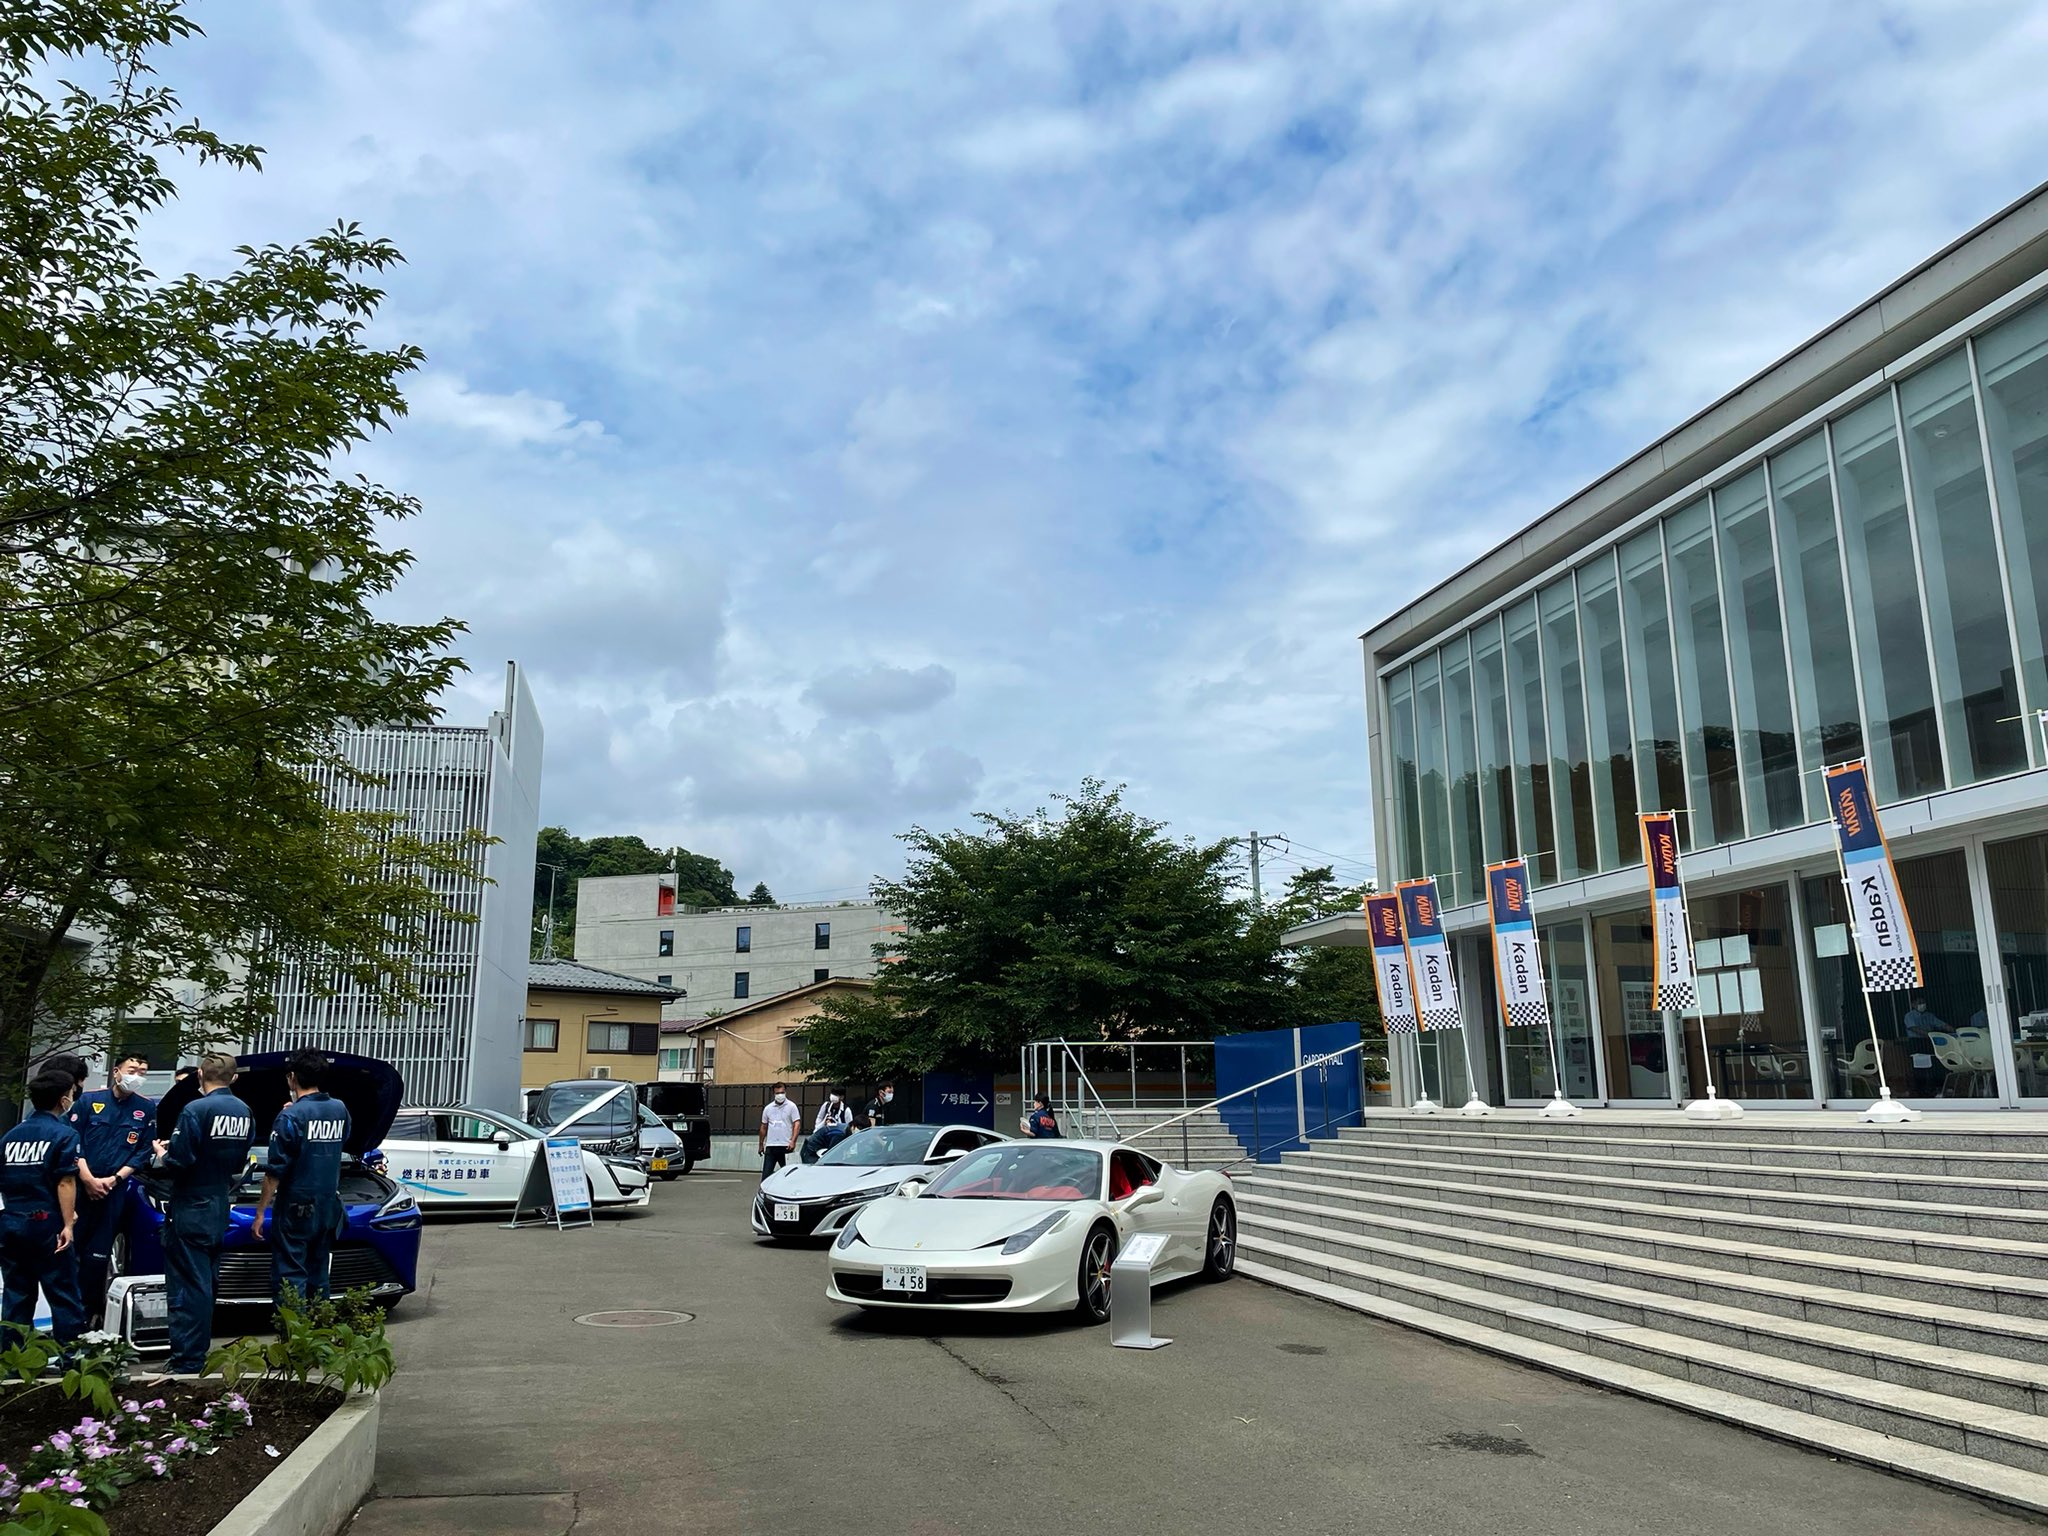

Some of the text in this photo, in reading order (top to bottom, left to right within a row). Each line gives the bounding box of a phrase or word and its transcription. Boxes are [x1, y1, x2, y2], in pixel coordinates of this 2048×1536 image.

[1660, 834, 1674, 874] KADAN
[1506, 878, 1521, 912] KADAN
[1382, 908, 1396, 937] KADAN
[1416, 896, 1433, 926] KADAN
[1426, 955, 1443, 1001] Kadan
[1512, 942, 1528, 994] Kadan
[1390, 964, 1403, 1008] Kadan
[940, 1093, 970, 1105] 7号館
[210, 1116, 250, 1137] KADAN
[308, 1120, 345, 1139] KADAN
[5, 1140, 51, 1162] KADAN
[402, 1169, 490, 1180] 燃料電池自動車
